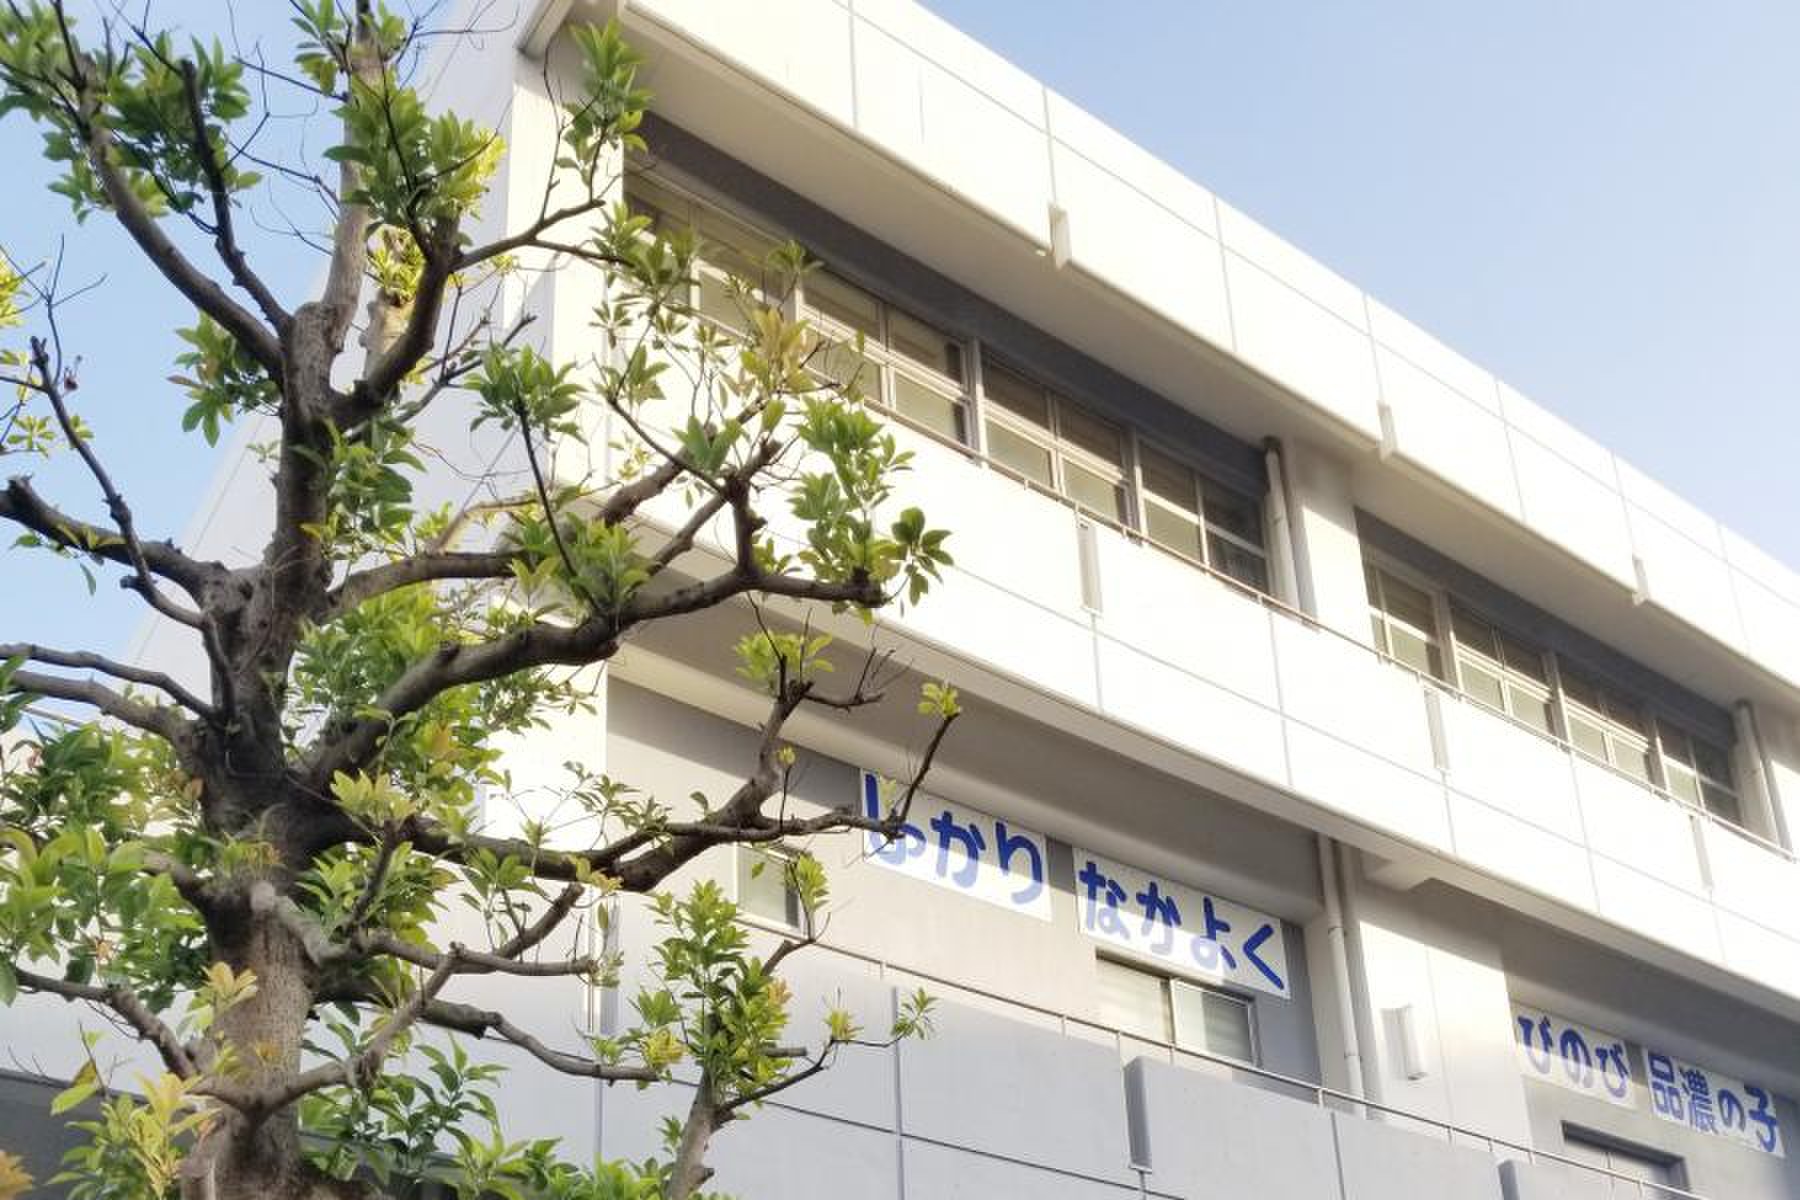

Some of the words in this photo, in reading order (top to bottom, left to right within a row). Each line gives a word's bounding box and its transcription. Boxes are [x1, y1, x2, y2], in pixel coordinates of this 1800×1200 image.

[1079, 860, 1285, 990] なかよく
[1648, 1052, 1778, 1153] 品濃の子
